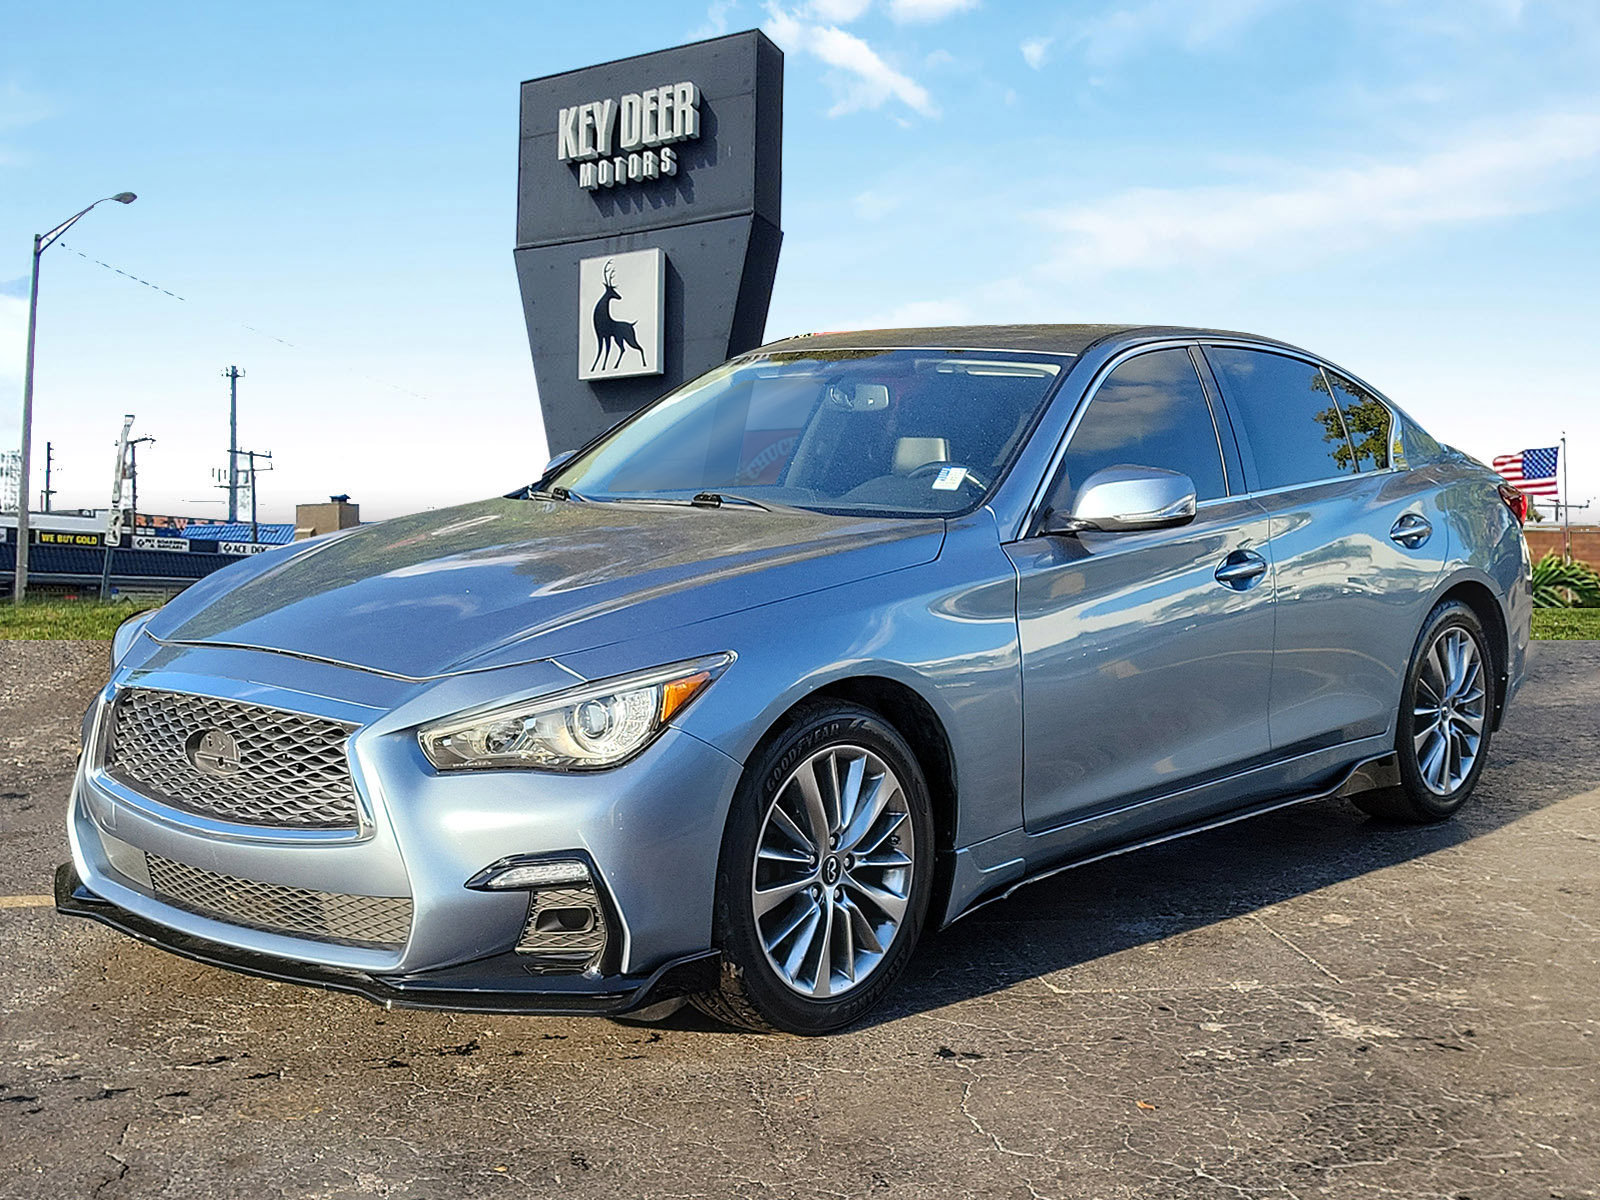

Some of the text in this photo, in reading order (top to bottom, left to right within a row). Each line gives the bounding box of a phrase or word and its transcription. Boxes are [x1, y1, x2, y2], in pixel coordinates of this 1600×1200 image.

[558, 81, 700, 162] KEY DEER
[579, 147, 677, 190] MOTORS
[41, 533, 97, 545] WE BUY GOLD
[233, 545, 247, 554] ACE
[766, 723, 840, 792] GOODYEAR
